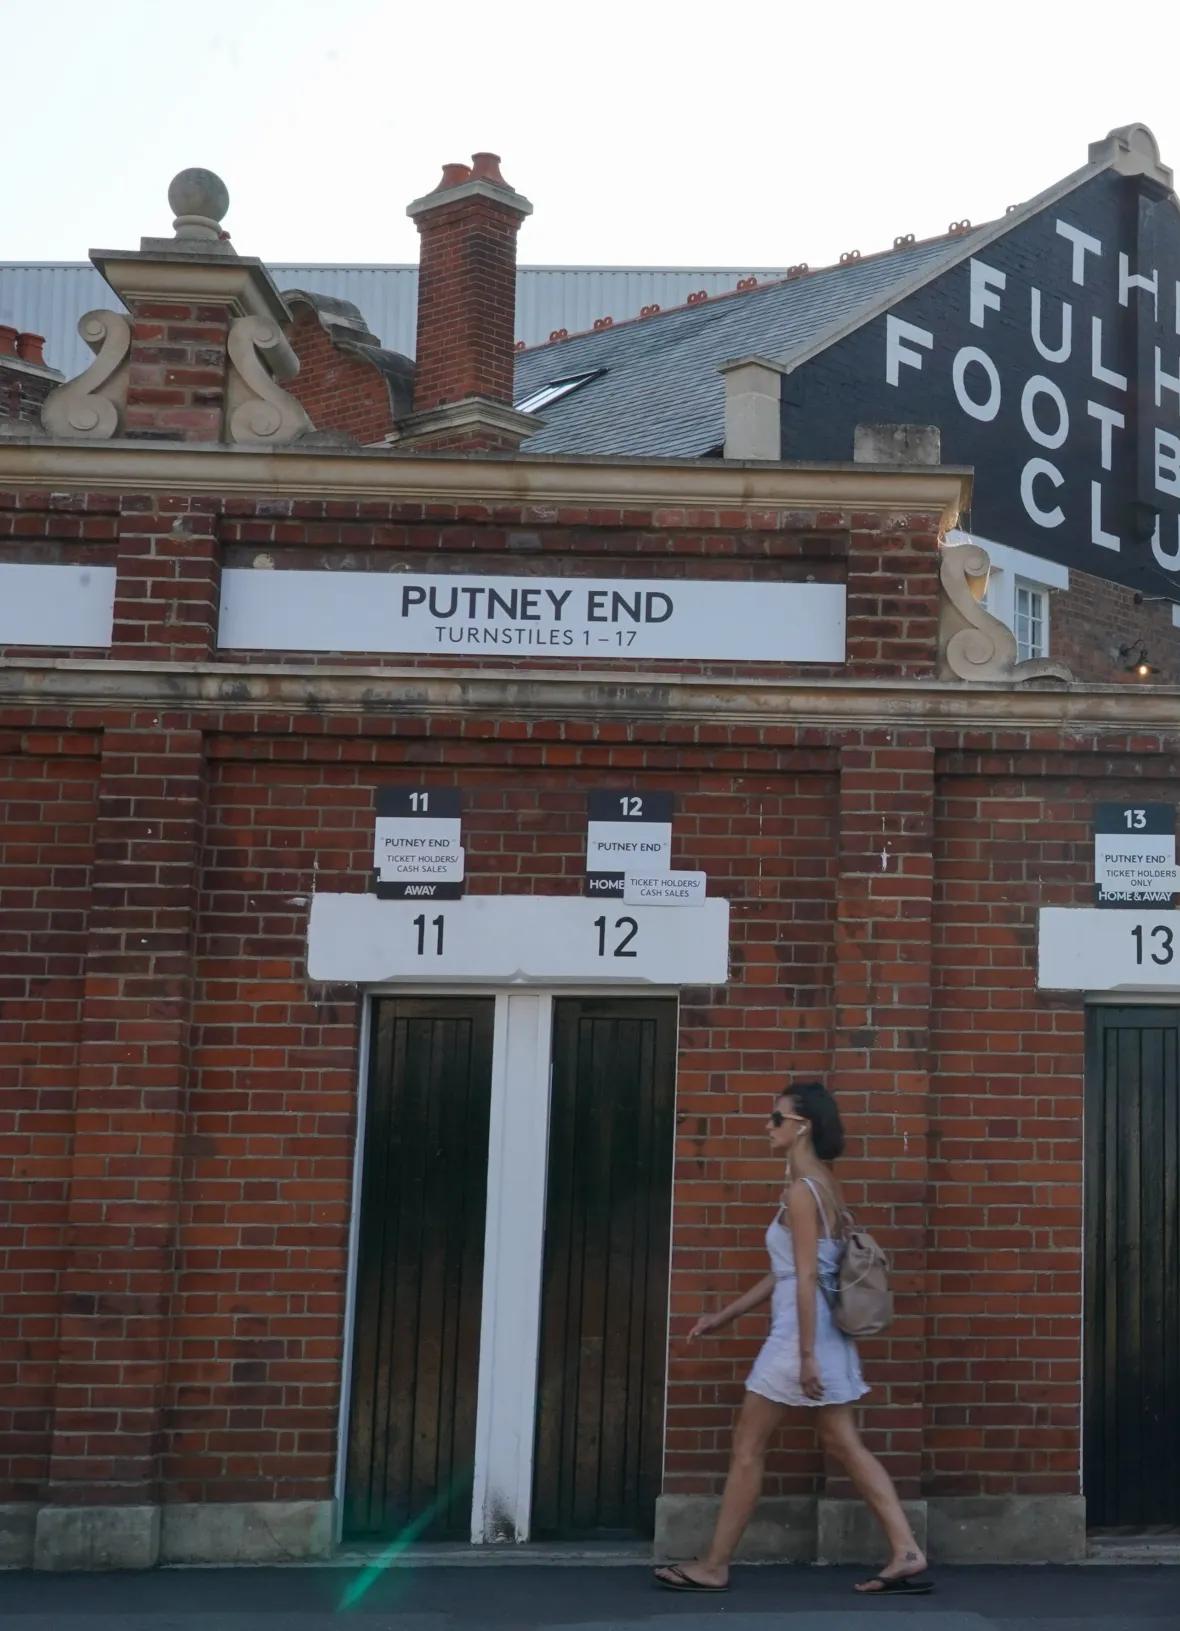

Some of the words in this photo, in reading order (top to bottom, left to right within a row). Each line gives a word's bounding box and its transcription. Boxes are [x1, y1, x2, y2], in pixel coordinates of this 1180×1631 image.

[401, 585, 572, 620] PUTNEY
[587, 590, 674, 623] END
[435, 626, 574, 645] TURNSTILES
[409, 792, 429, 812] 11
[619, 796, 643, 816] 12
[1123, 809, 1147, 829] 13
[385, 838, 427, 847] PUTNEY
[428, 839, 450, 848] END
[597, 842, 638, 851] PUTNEY
[640, 843, 662, 852] END
[386, 855, 416, 863] TICKET
[418, 855, 459, 863] HOLDERS/
[1105, 854, 1144, 863] PUTNEY
[1145, 855, 1166, 864] END
[396, 865, 419, 873] CASH
[421, 865, 447, 873] SALES
[1106, 869, 1135, 877] TICKET
[1137, 870, 1177, 878] HOLDERS
[630, 878, 659, 887] TICKET
[661, 879, 701, 888] HOLDERS/
[1130, 879, 1153, 887] ONLY
[404, 885, 436, 895] AWAY
[640, 888, 662, 897] CASH
[664, 889, 689, 897] SALES
[413, 914, 444, 956] 11
[593, 915, 639, 957] 12
[1130, 924, 1174, 965] 13
